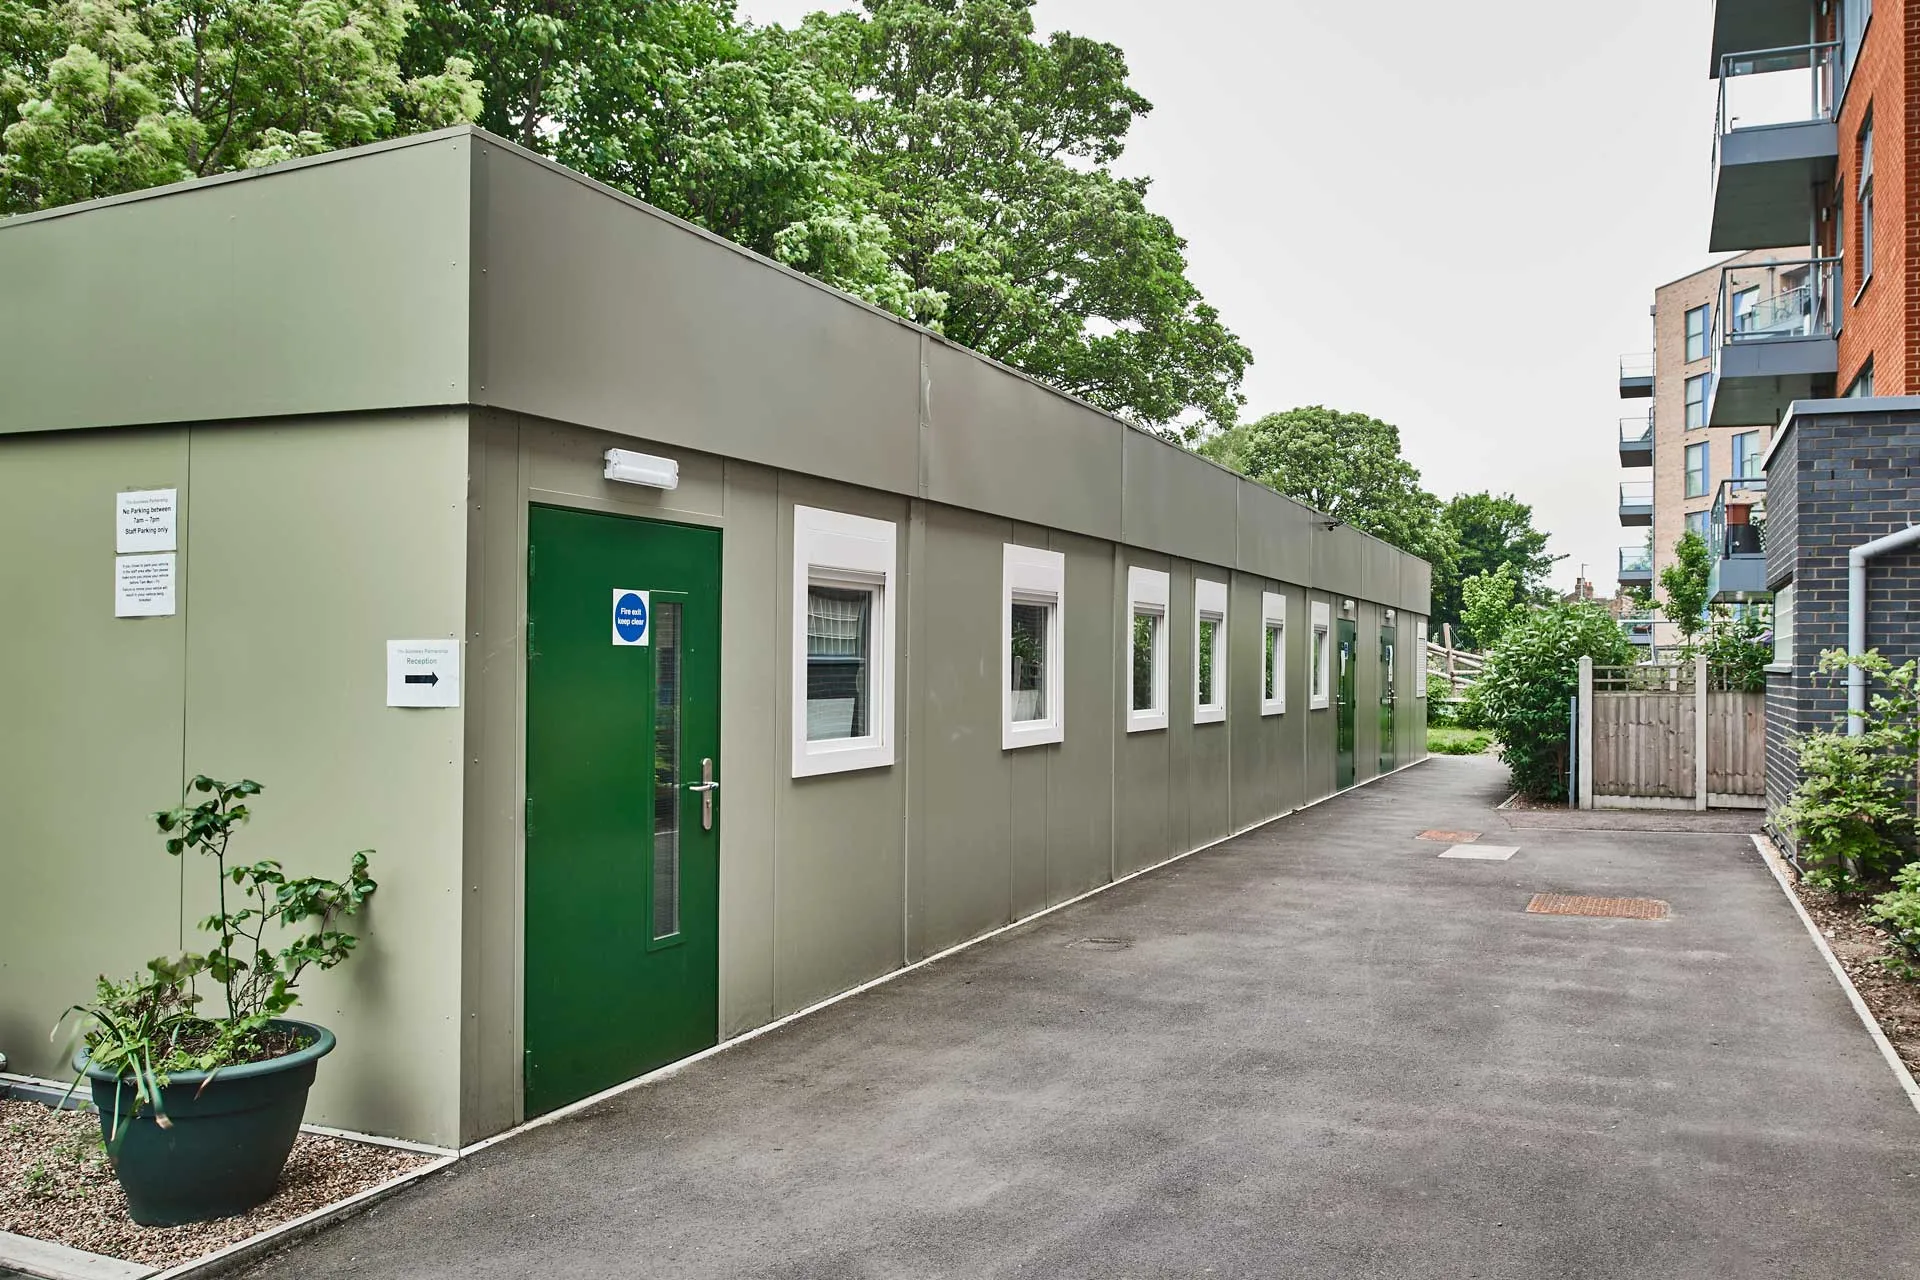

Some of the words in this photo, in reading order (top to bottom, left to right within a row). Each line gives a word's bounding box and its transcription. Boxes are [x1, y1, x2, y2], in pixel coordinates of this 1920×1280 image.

[130, 507, 150, 515] Parking
[137, 527, 157, 535] Parking
[157, 526, 169, 534] only
[620, 607, 631, 615] Fire
[617, 617, 631, 627] keep
[631, 618, 644, 626] clear
[406, 657, 438, 666] Reception
